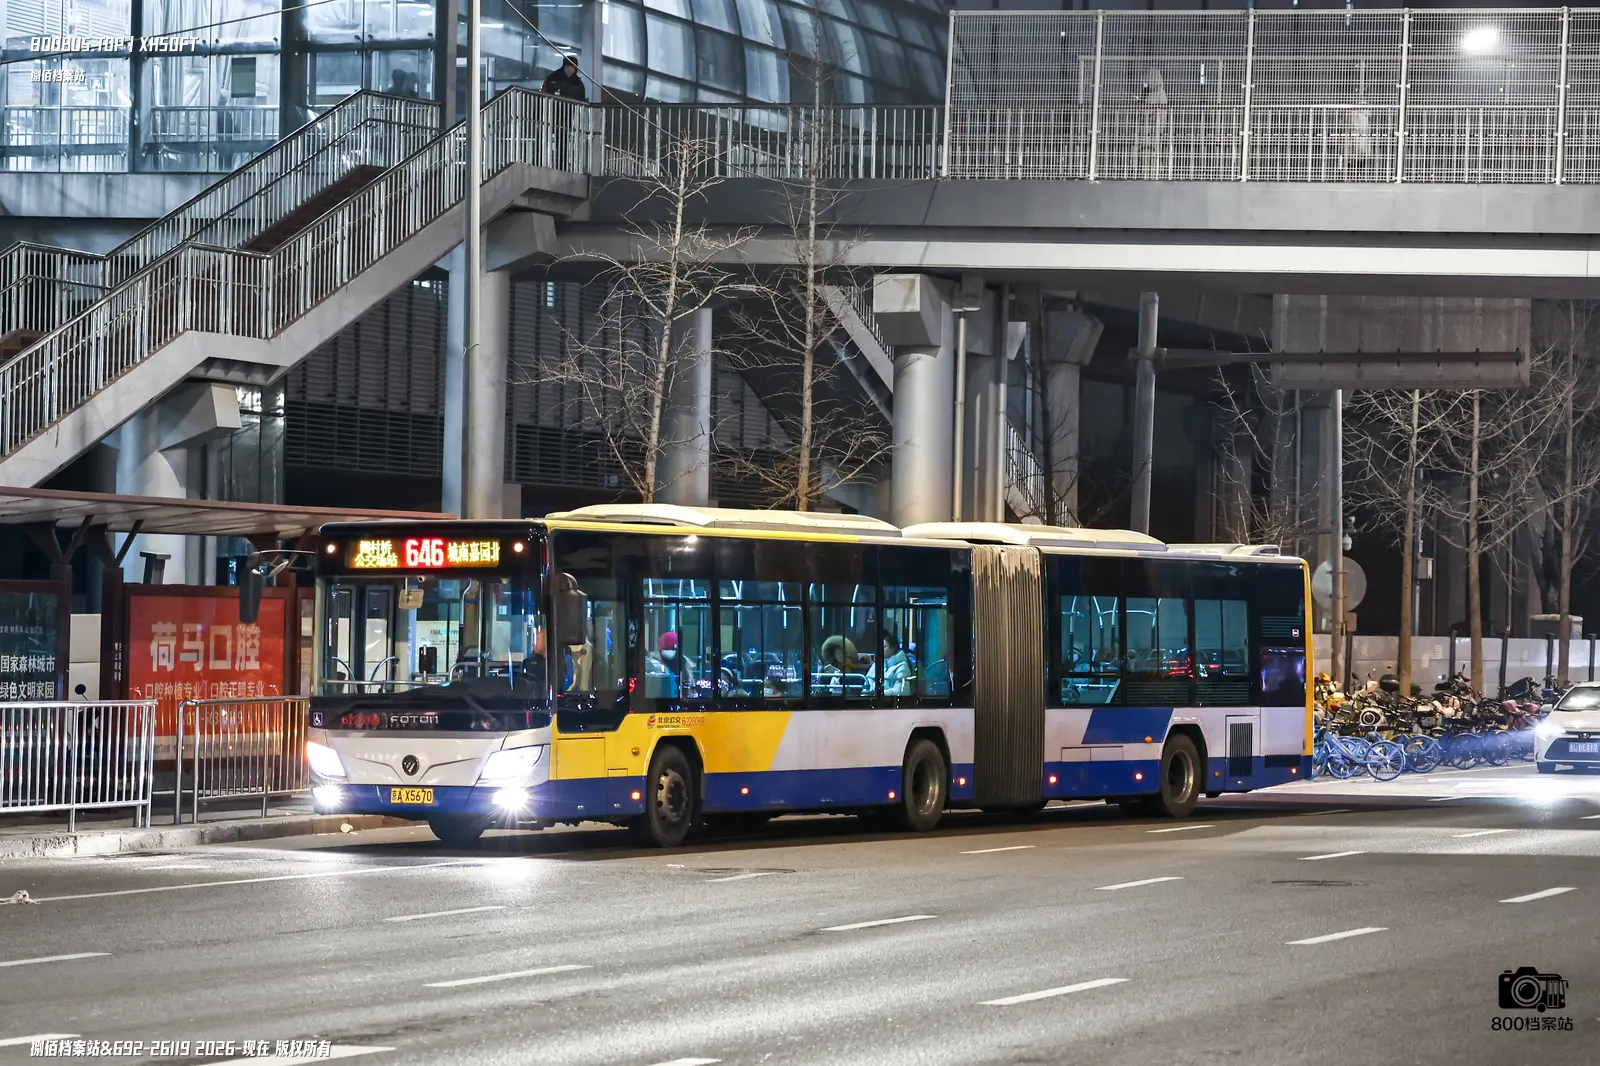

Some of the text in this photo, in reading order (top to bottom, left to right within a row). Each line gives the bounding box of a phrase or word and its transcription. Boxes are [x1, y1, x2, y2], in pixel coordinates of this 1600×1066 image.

[359, 540, 393, 554] 村桥
[405, 538, 445, 567] 646
[447, 541, 501, 563] 城南嘉园北
[149, 621, 261, 673] 荷马口腔
[0, 654, 56, 674] 国家森林城市
[0, 681, 56, 699] 绿色文明家园
[390, 715, 439, 724] FOTON
